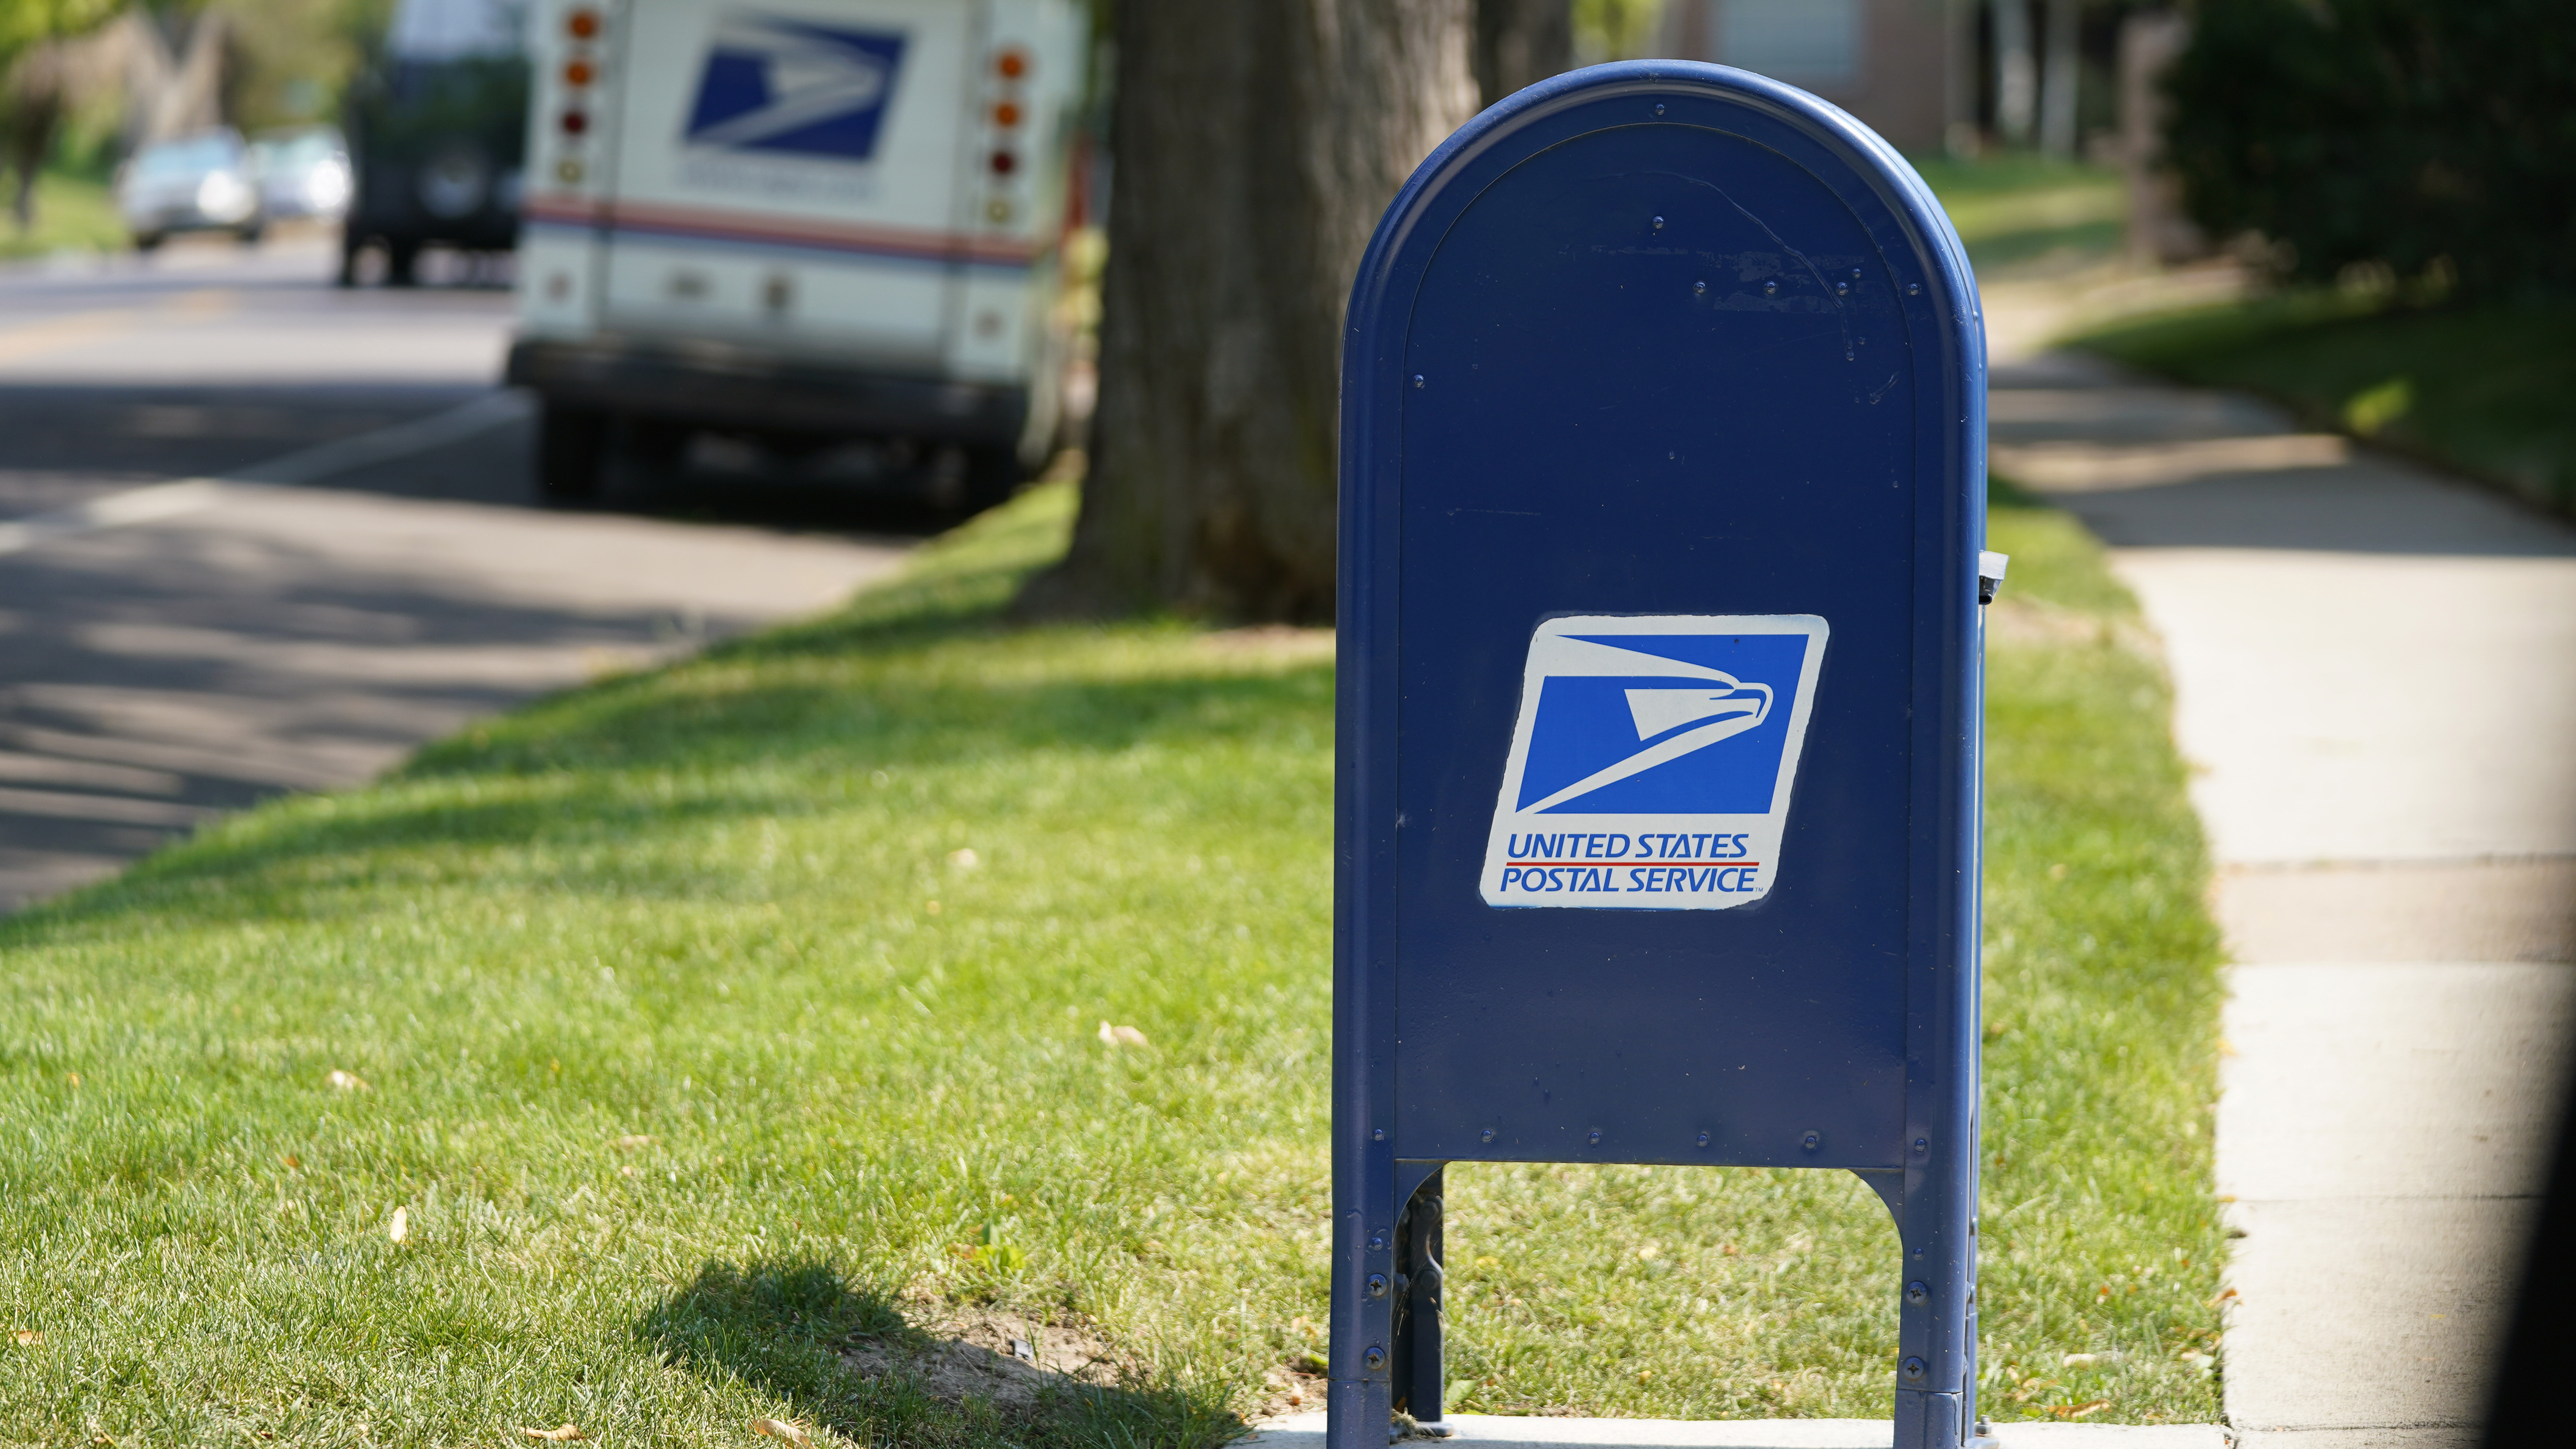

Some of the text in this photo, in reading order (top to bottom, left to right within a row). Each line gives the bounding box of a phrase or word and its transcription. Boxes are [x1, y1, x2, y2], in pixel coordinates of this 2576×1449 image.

[1508, 833, 1749, 858] UNITED STATES
[1500, 868, 1619, 892] POSTAL
[1627, 868, 1758, 892] SERVICE
